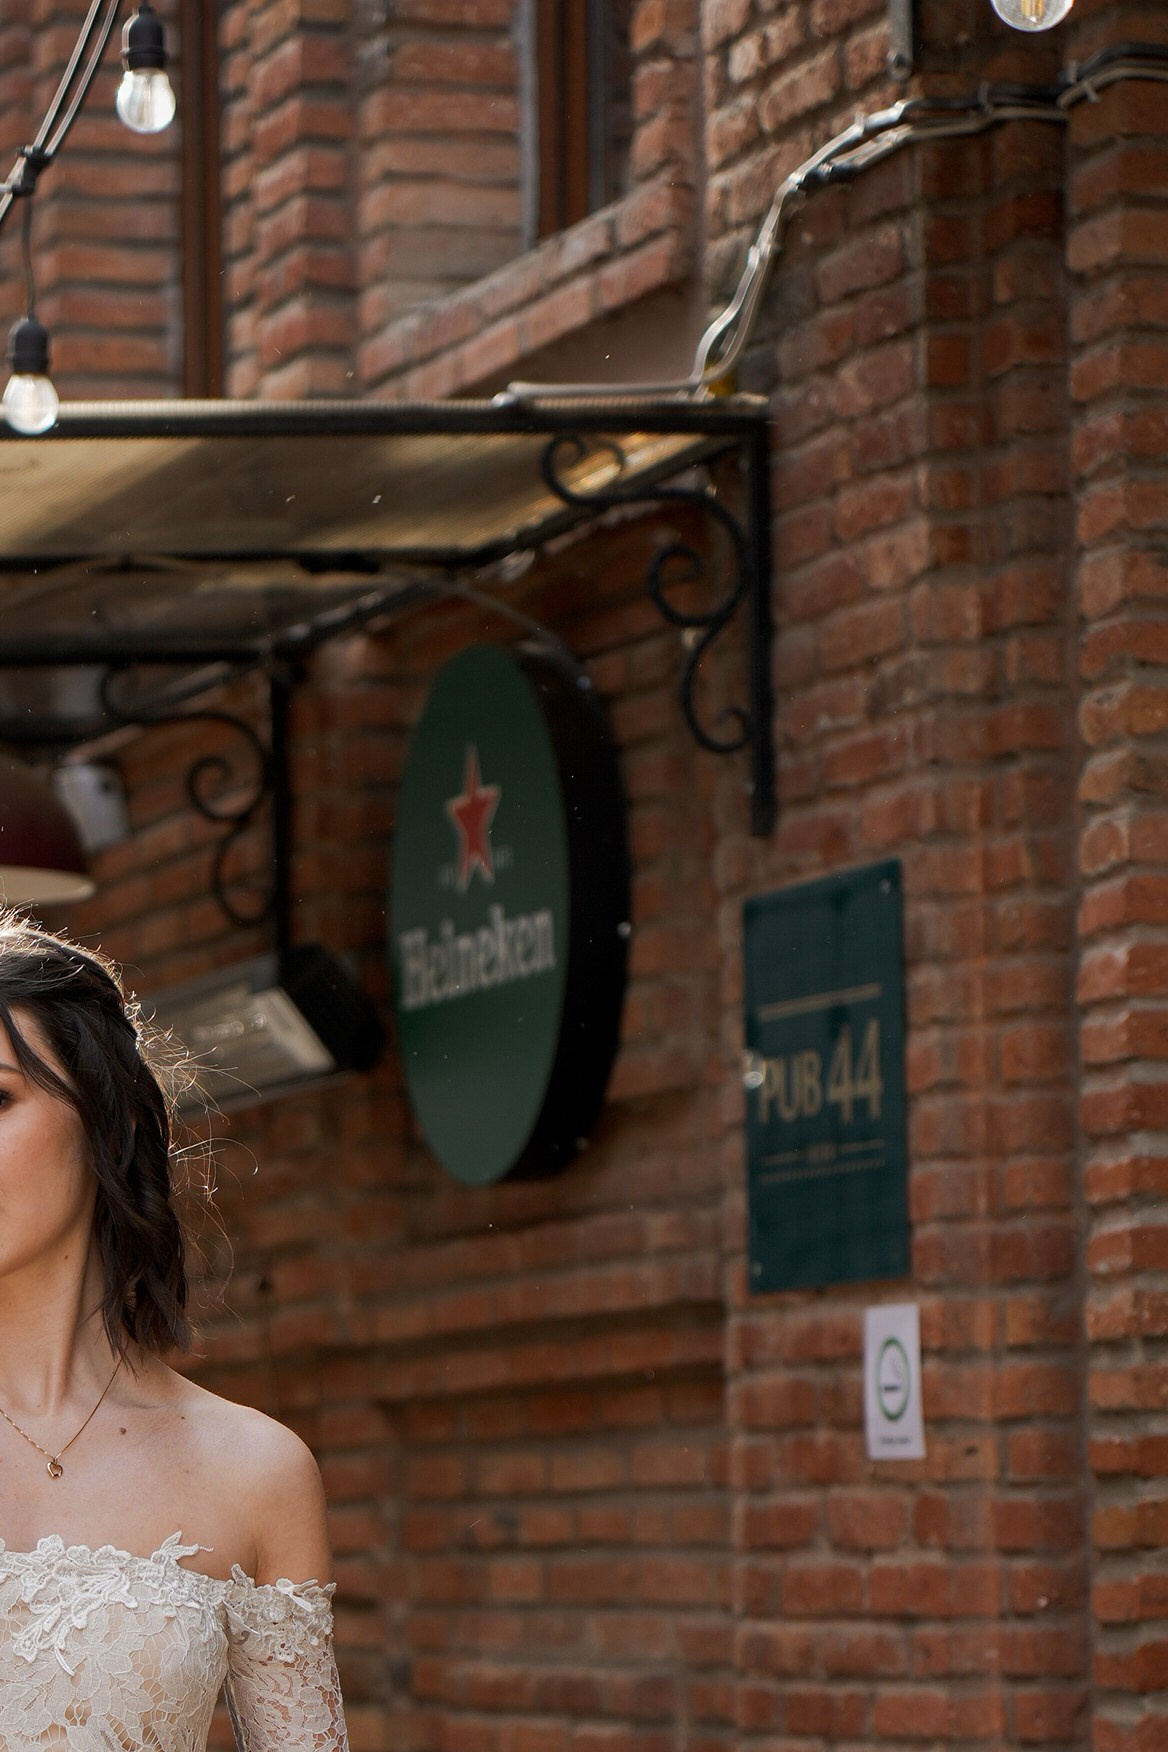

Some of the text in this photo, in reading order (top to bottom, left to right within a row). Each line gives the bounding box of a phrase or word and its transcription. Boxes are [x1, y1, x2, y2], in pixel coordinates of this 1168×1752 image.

[401, 905, 555, 1010] Heineken
[759, 1019, 883, 1123] PUB 44
